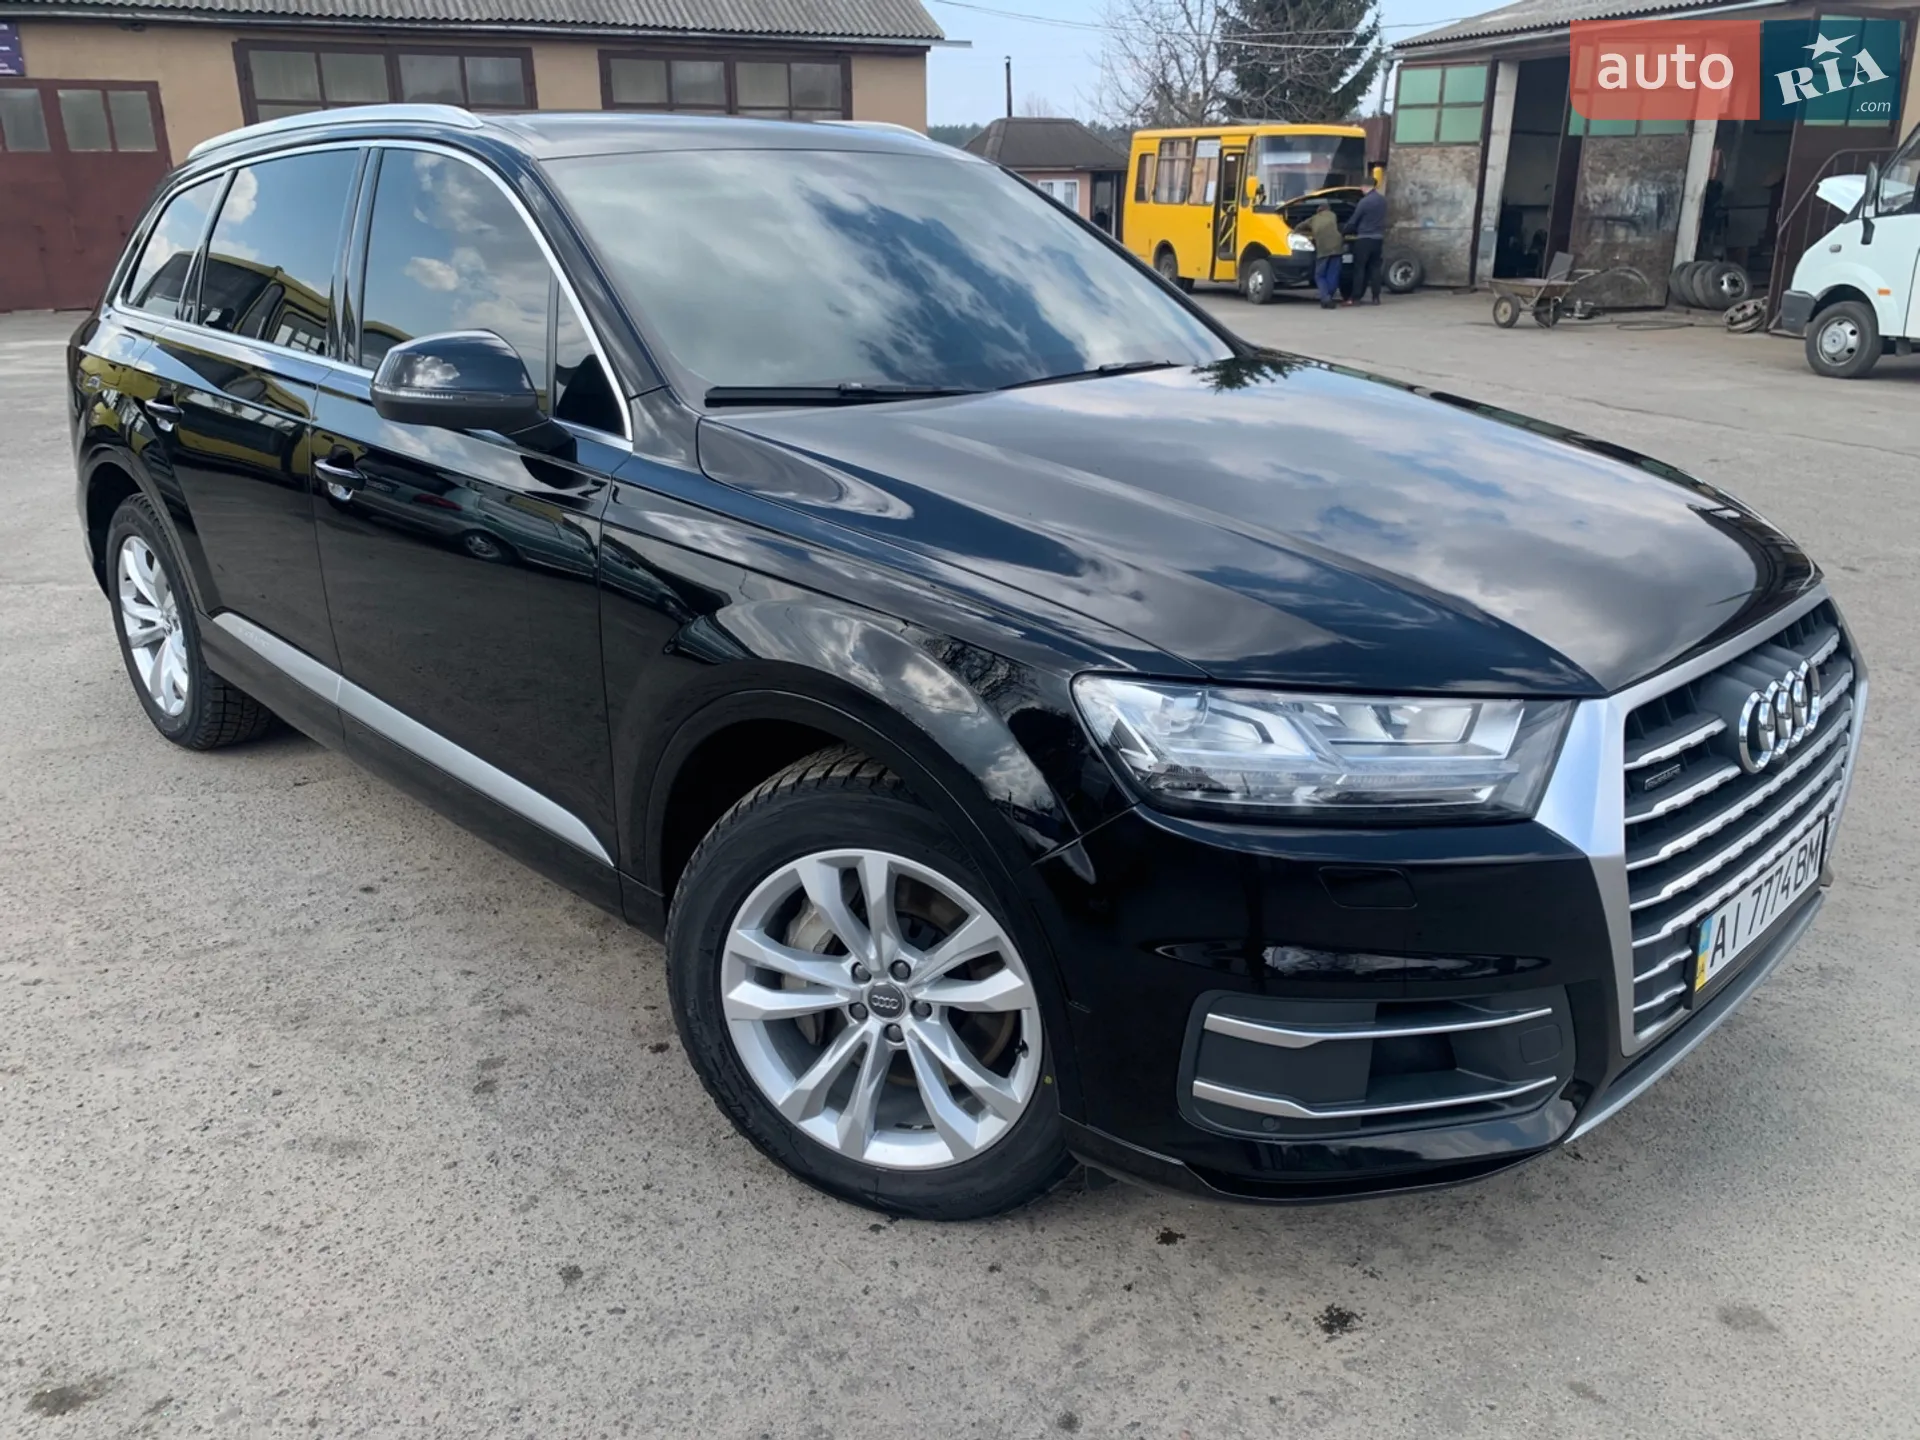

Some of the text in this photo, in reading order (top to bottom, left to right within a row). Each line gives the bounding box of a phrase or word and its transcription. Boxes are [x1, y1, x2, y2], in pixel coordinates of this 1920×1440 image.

[1709, 830, 1822, 968] AI 7774 BM
